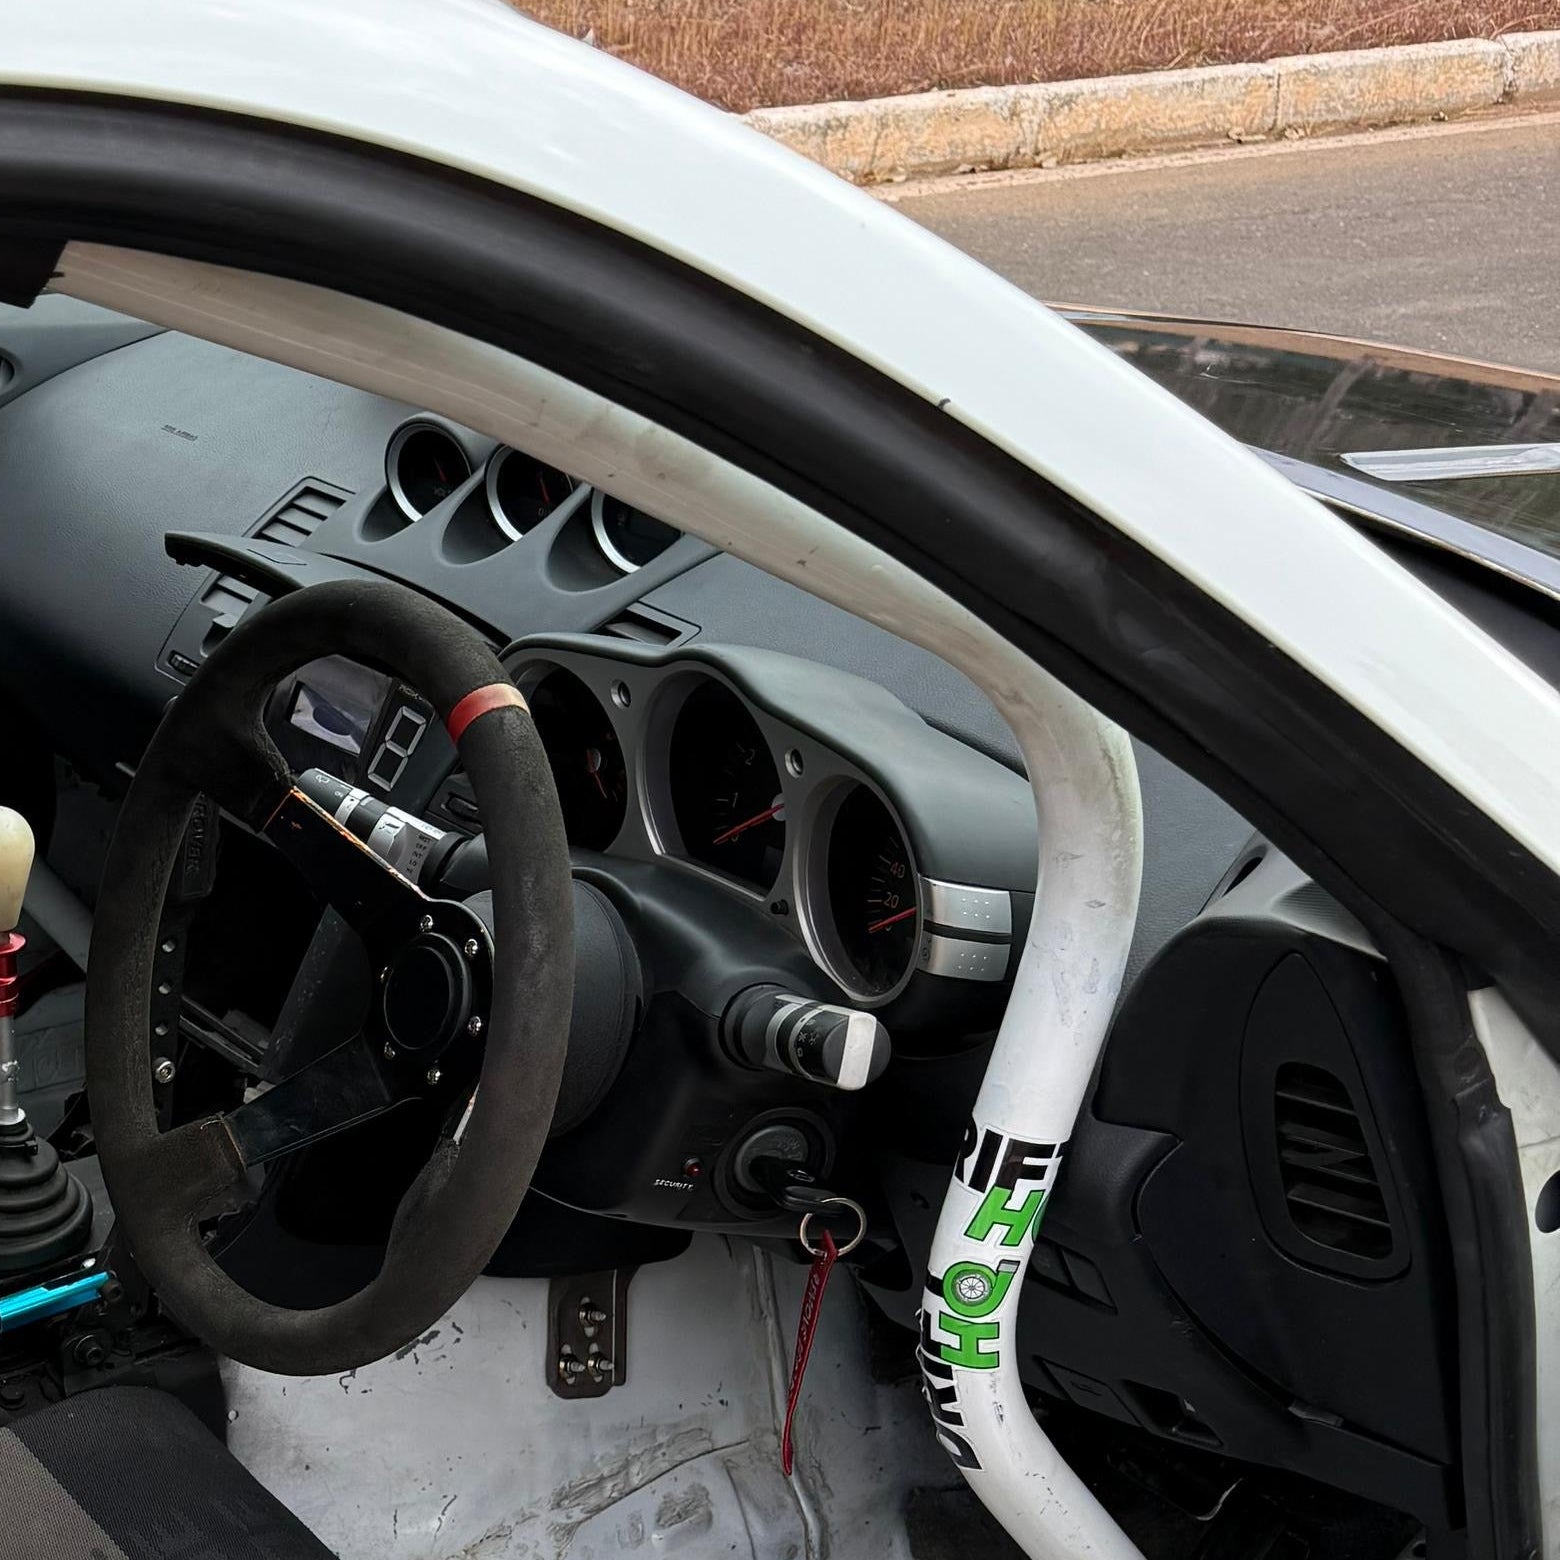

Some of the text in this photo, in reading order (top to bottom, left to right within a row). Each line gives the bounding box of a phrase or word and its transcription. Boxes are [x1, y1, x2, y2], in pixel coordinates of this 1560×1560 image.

[890, 862, 906, 880] 40
[884, 893, 900, 910] 20
[653, 1178, 695, 1190] SECURITY
